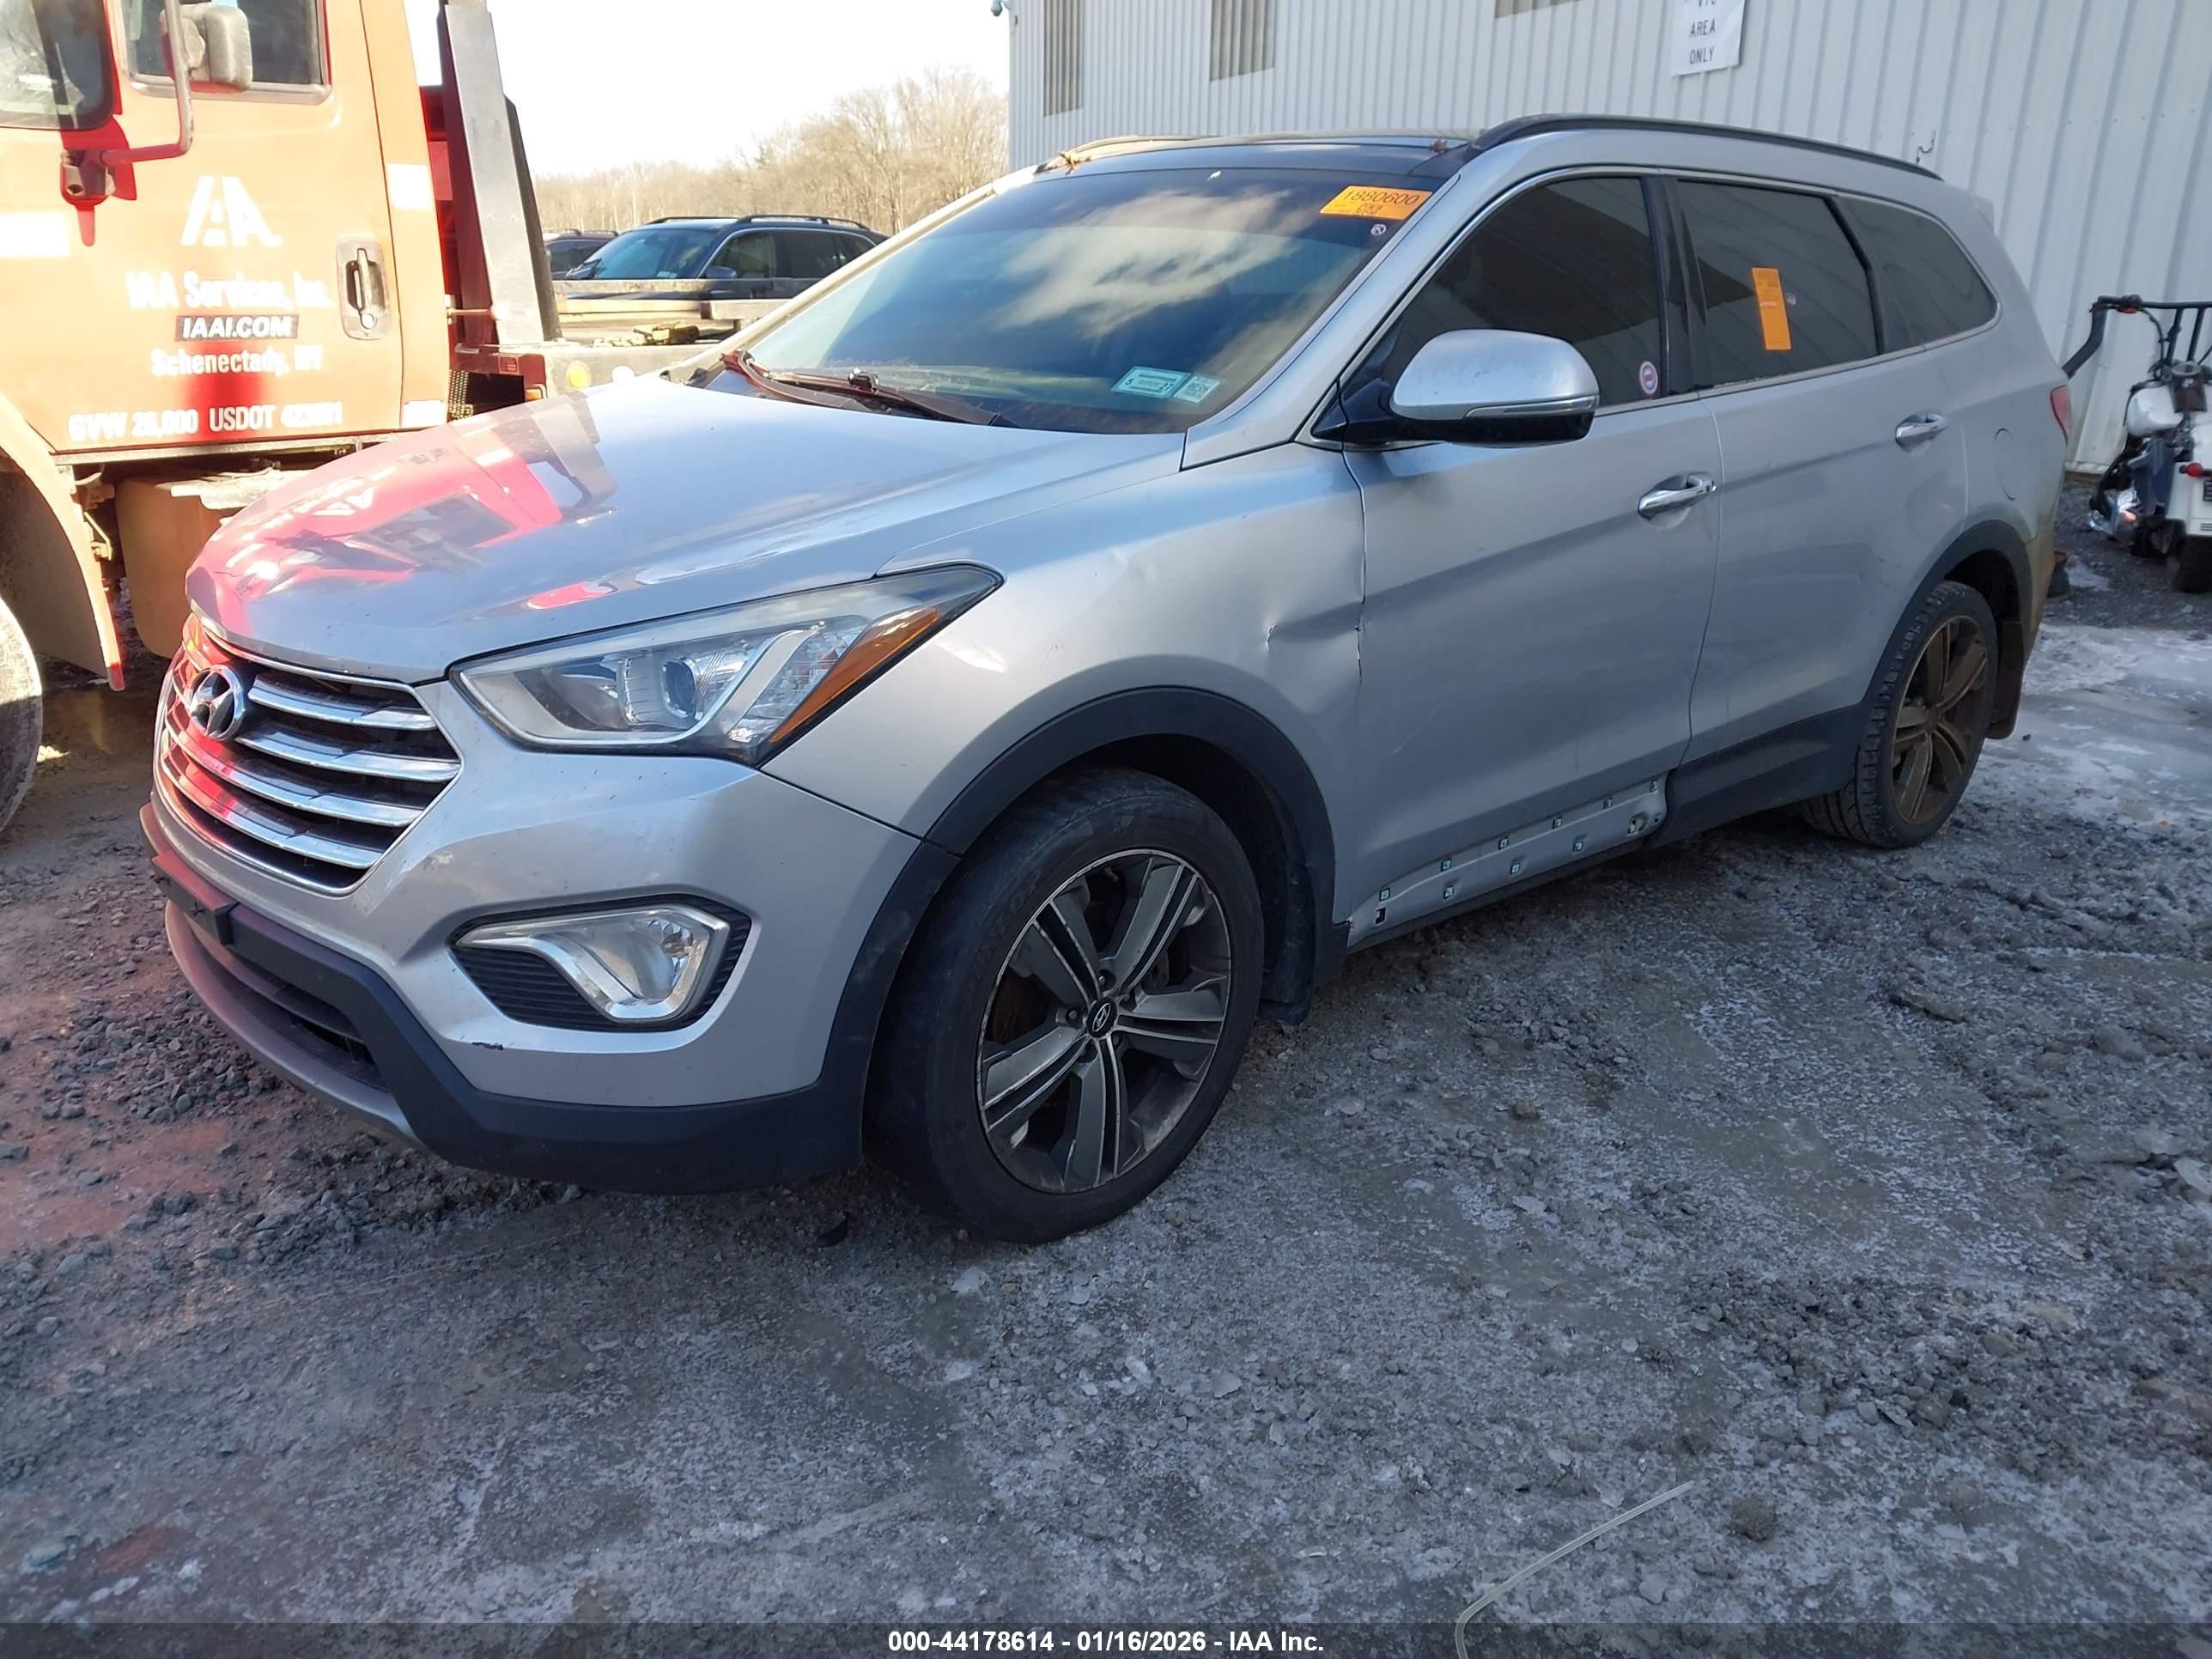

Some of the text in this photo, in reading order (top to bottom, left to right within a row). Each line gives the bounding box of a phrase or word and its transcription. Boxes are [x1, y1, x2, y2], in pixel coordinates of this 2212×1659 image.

[1689, 18, 1716, 37] AREA
[1689, 46, 1716, 64] ONLY
[1343, 189, 1420, 205] 1880600
[183, 315, 291, 338] IAAI.COM
[209, 404, 276, 431] USDOT
